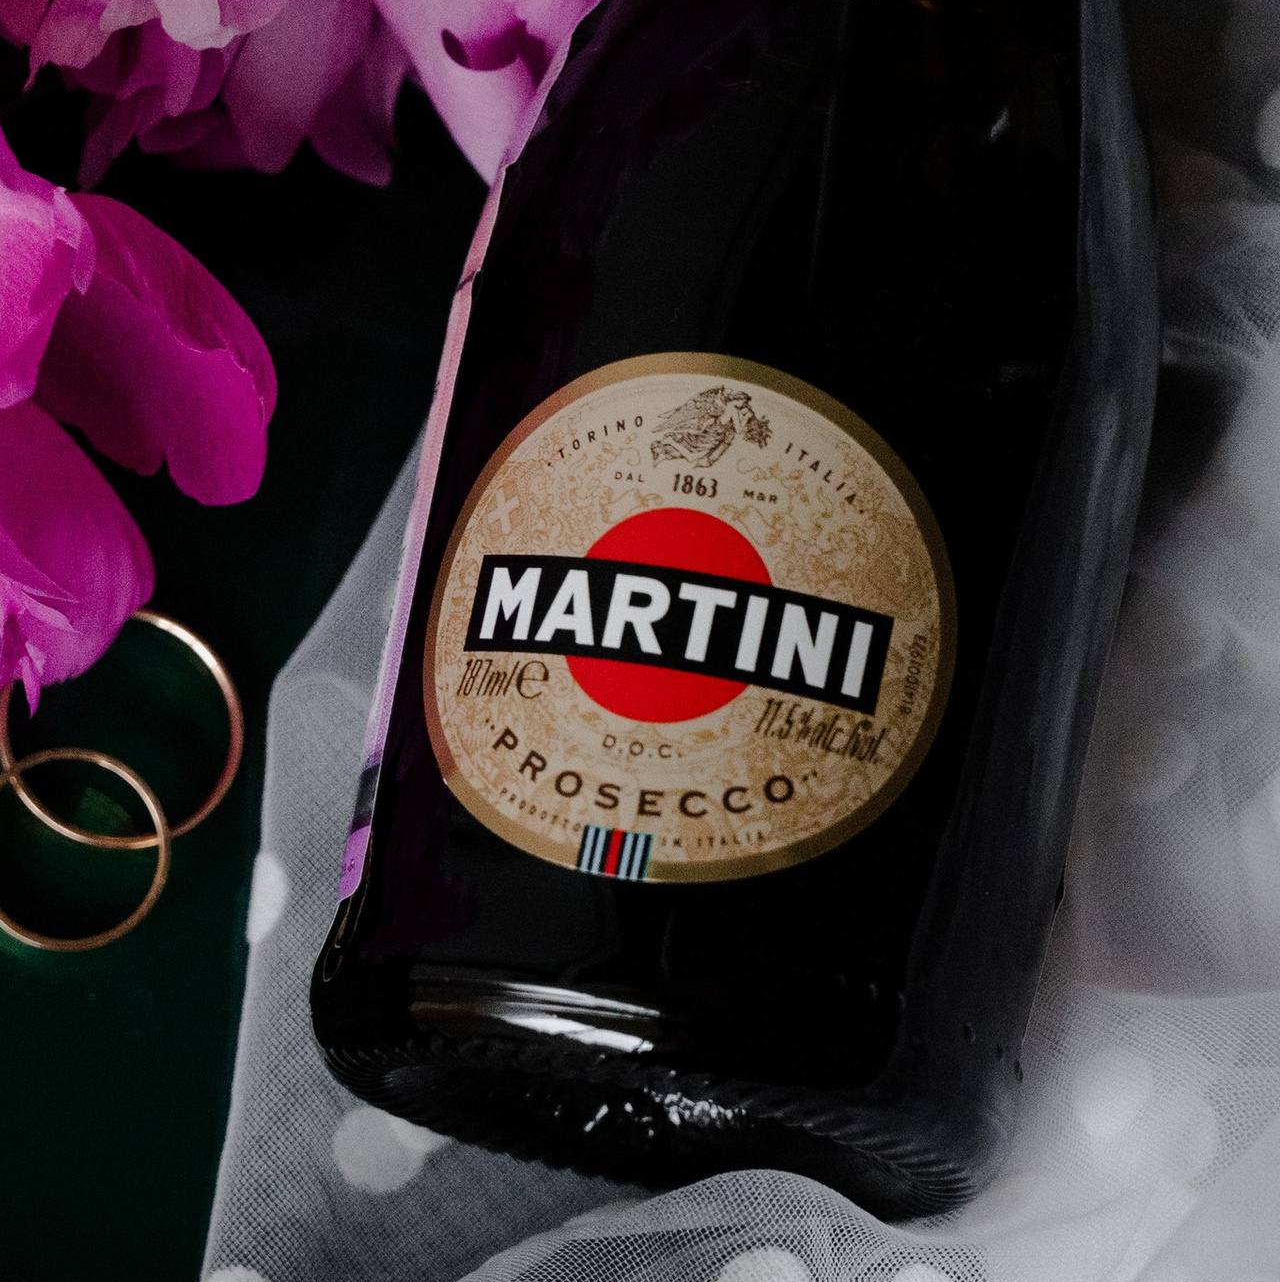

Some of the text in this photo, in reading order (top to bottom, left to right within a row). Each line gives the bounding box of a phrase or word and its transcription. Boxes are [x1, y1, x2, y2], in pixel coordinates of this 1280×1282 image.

[558, 415, 644, 459] TORINO
[614, 471, 646, 483] DAL
[672, 472, 719, 499] 1863
[784, 441, 858, 506] ITALIA
[479, 565, 875, 700] MARTINI
[602, 733, 684, 759] D.O.C.
[491, 726, 795, 818] PROSECCO
